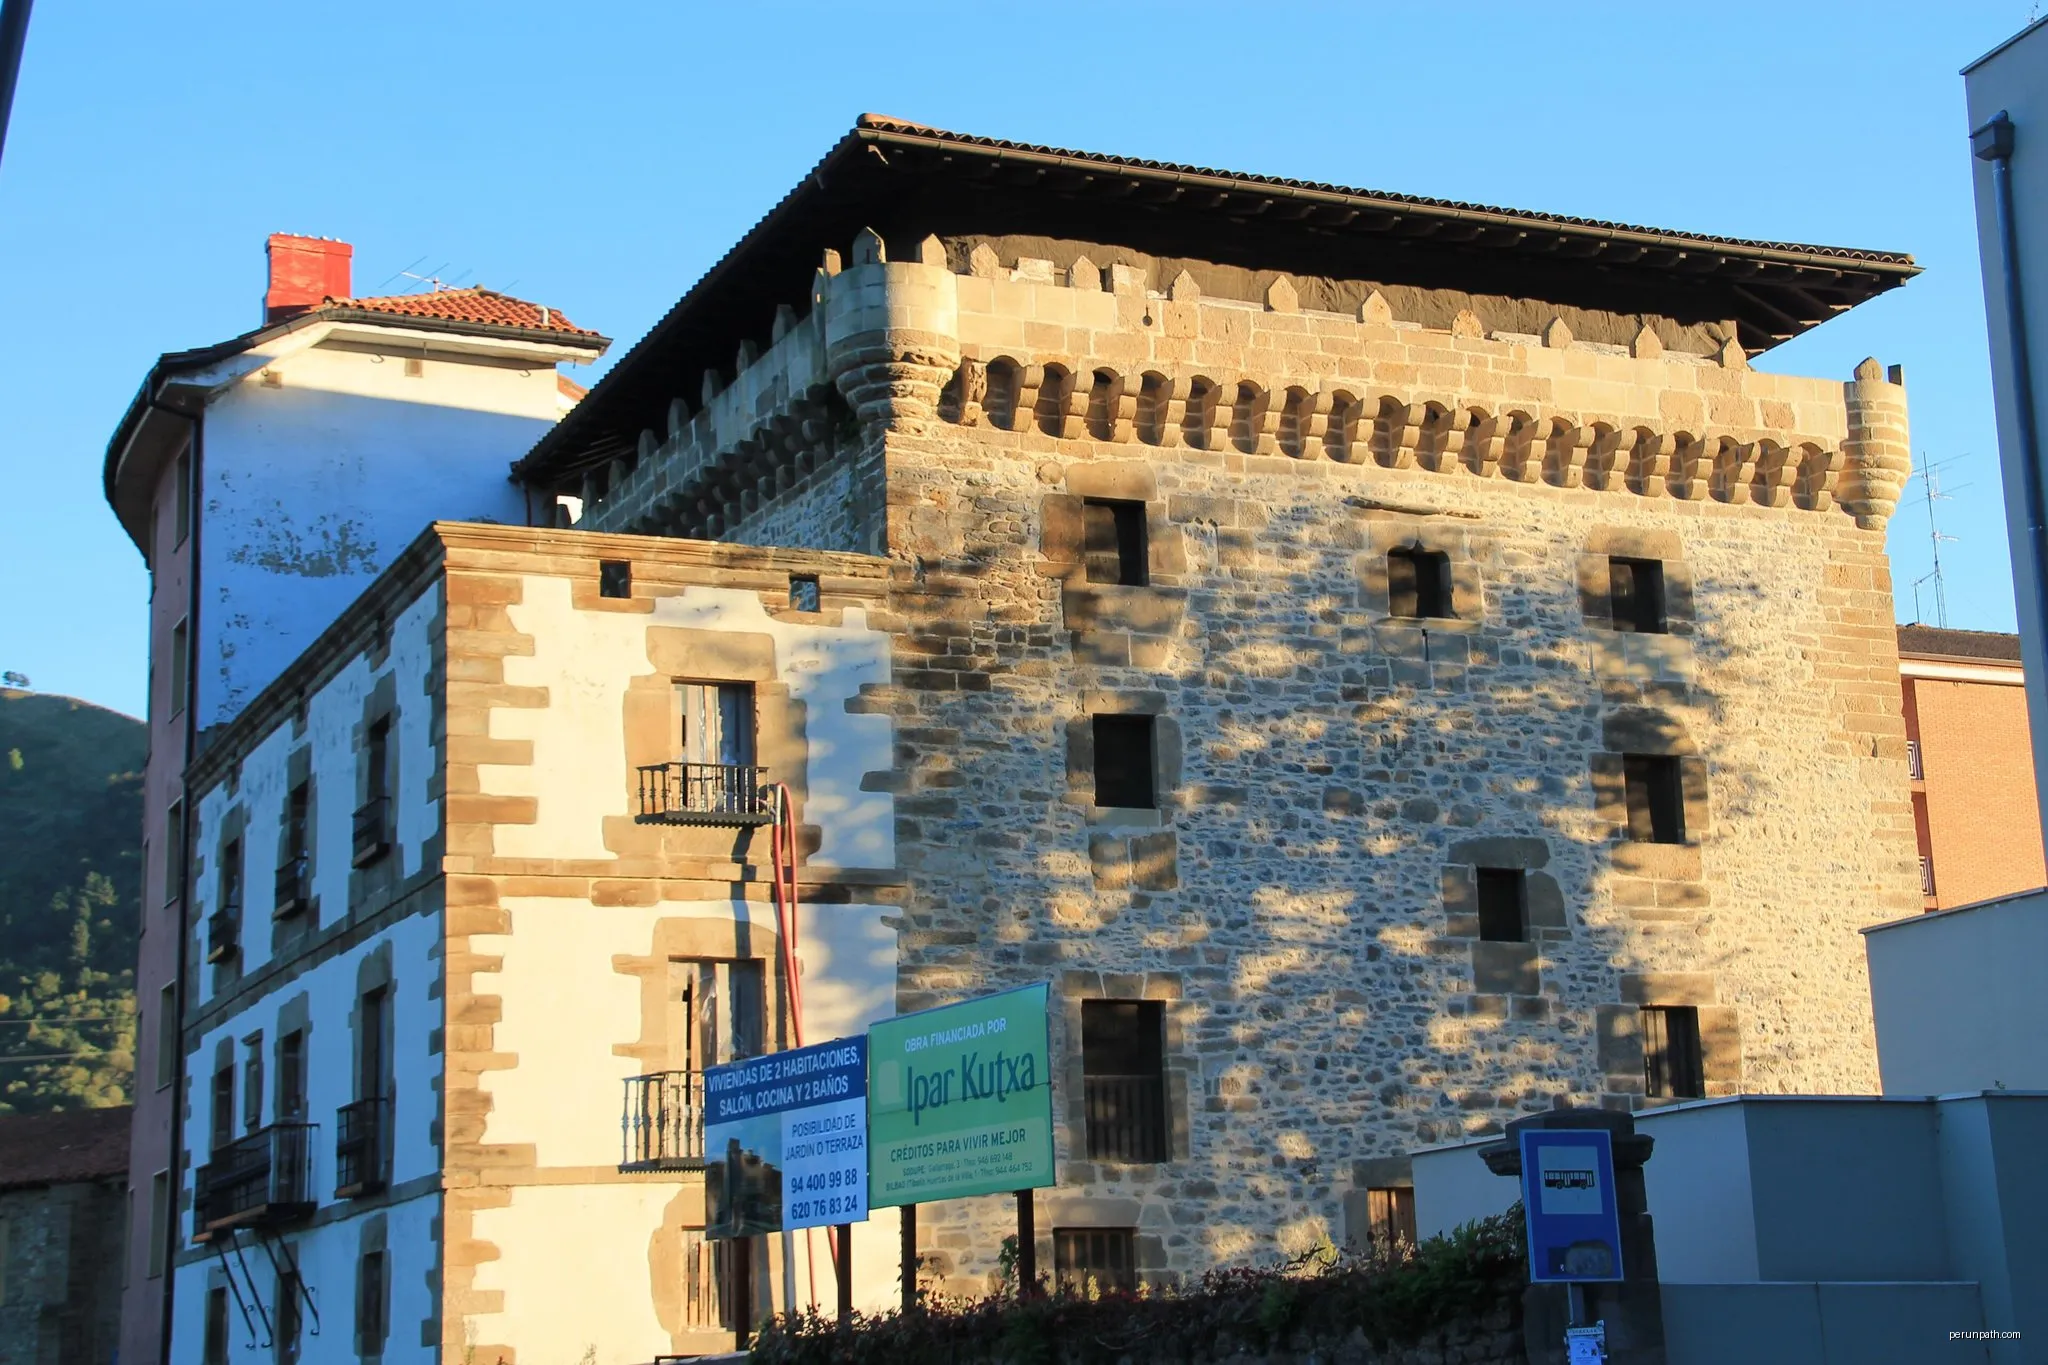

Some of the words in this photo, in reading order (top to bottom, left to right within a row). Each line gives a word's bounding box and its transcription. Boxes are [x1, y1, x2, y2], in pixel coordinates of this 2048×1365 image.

[905, 1035, 928, 1052] OBRA
[931, 1022, 985, 1047] FINANCIADA
[987, 1017, 1006, 1035] POR
[708, 1069, 757, 1093] VIVIENDAS
[759, 1065, 773, 1082] DE
[774, 1063, 781, 1079] 2
[783, 1046, 860, 1078] HABITACIONES,
[719, 1091, 754, 1117] SALÓN,
[756, 1088, 794, 1109] COCINA
[795, 1084, 803, 1099] Y
[804, 1084, 811, 1099] 2
[813, 1074, 848, 1098] BAÑOS
[907, 1066, 955, 1125] Ipar
[961, 1050, 1035, 1103] Kutxa
[792, 1116, 842, 1138] POSIBILIDAD
[843, 1113, 856, 1129] DE
[785, 1140, 815, 1161] JARDÍN
[817, 1141, 824, 1155] O
[825, 1135, 864, 1154] TERRAZA
[891, 1143, 934, 1162] CRÉDITOS
[937, 1139, 960, 1155] PARA
[964, 1134, 988, 1150] VIVIR
[991, 1128, 1026, 1145] MEJOR
[791, 1177, 804, 1194] 94
[806, 1173, 826, 1190] 400
[829, 1171, 842, 1188] 99
[844, 1168, 857, 1186] 88
[791, 1202, 810, 1220] 620
[814, 1199, 826, 1217] 76
[829, 1197, 842, 1214] 83
[844, 1195, 858, 1213] 24
